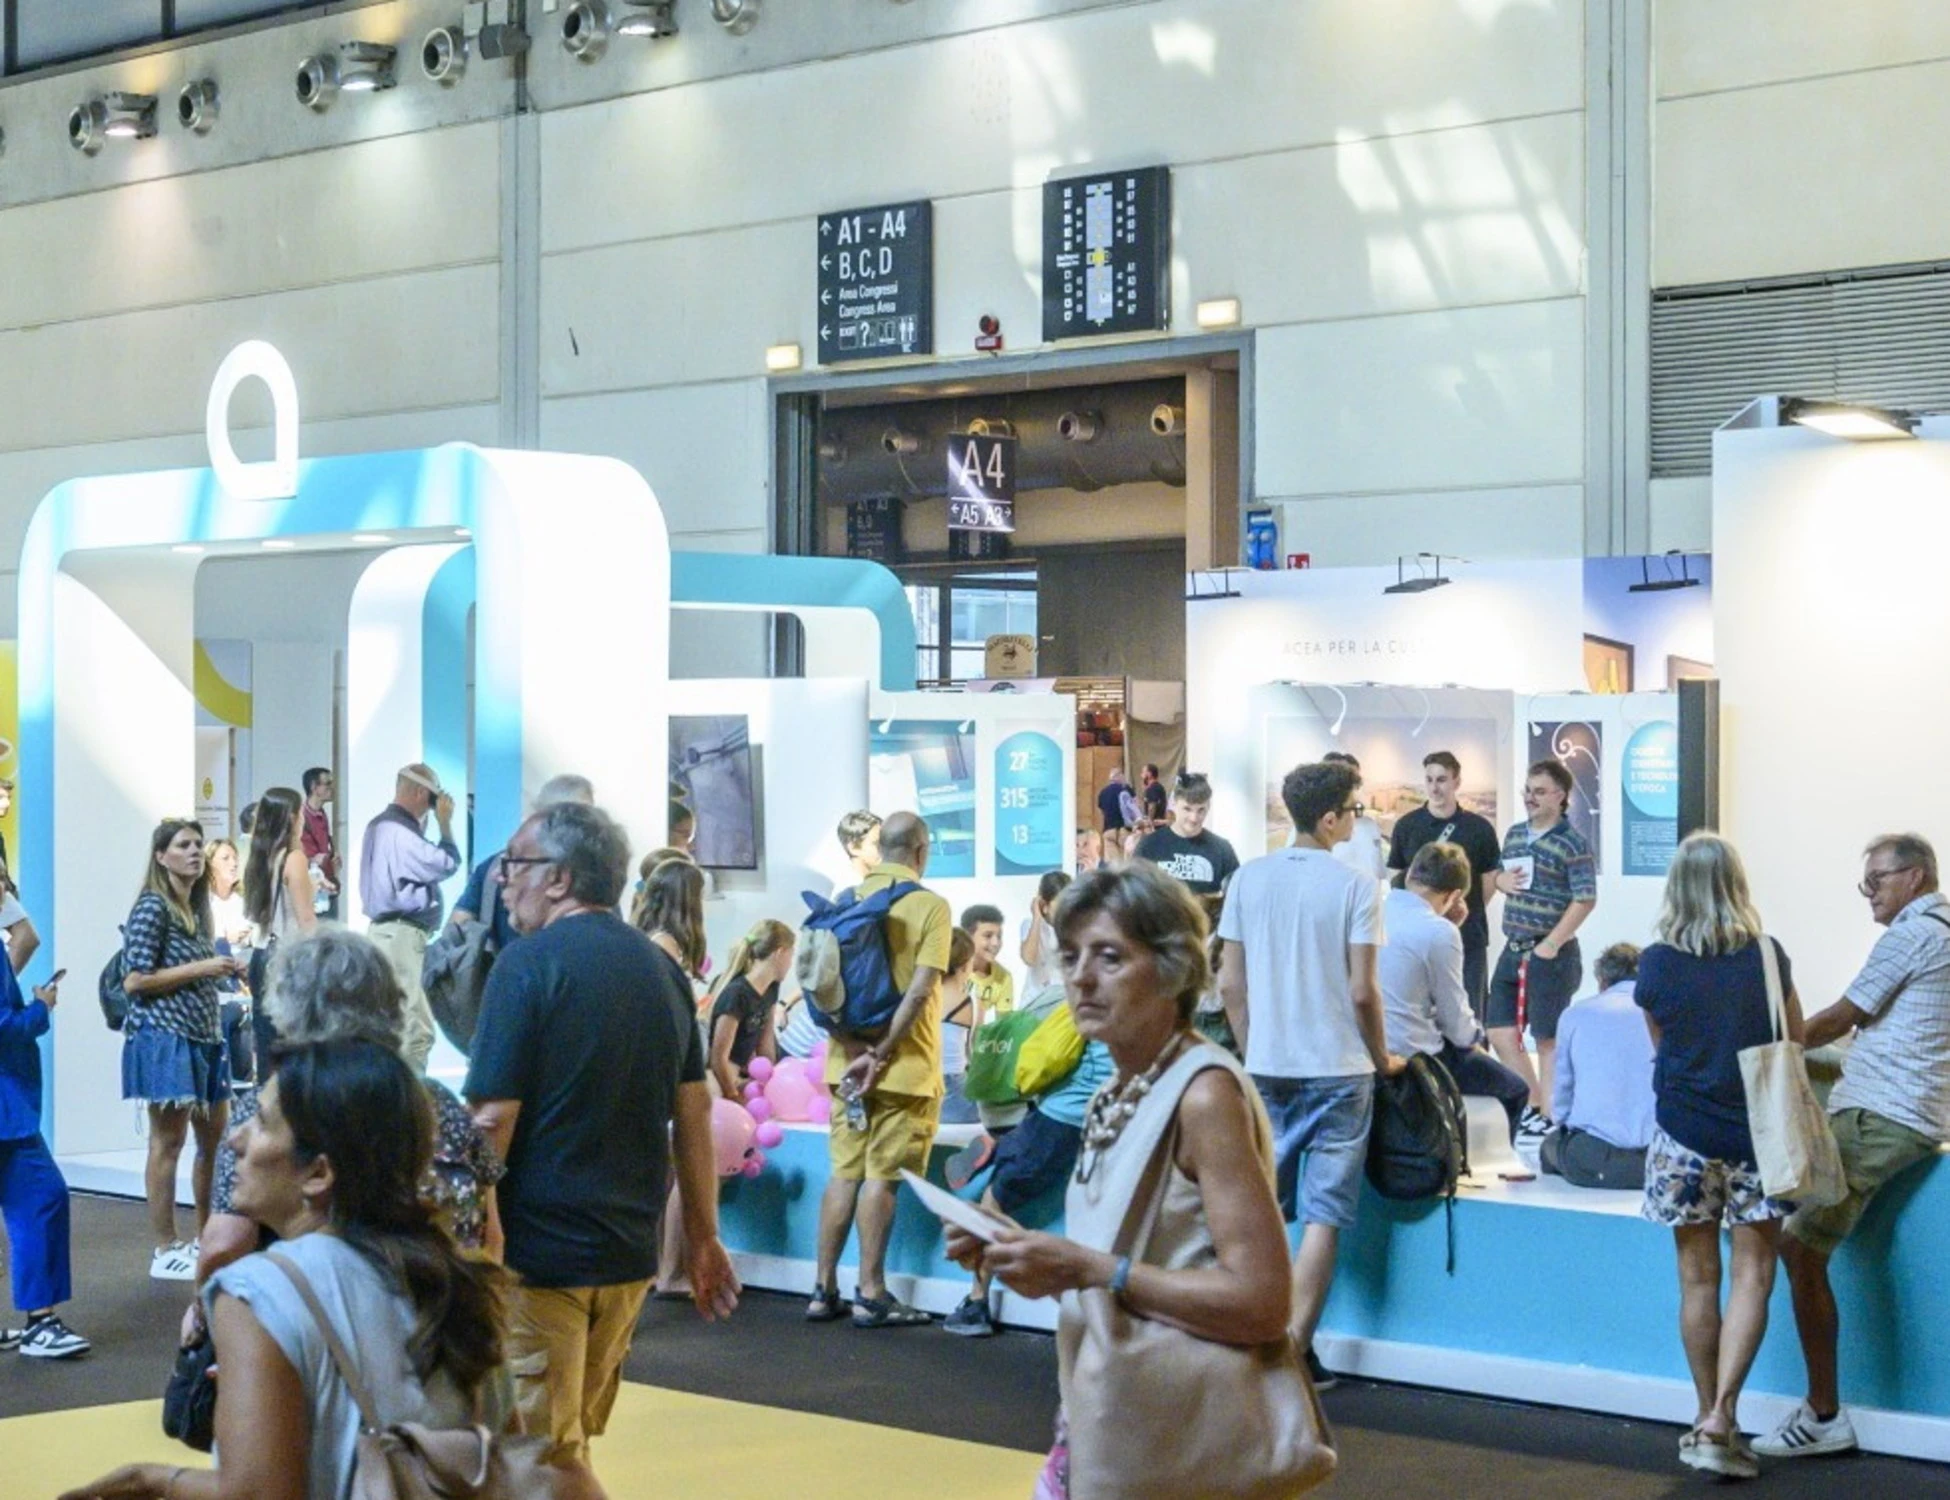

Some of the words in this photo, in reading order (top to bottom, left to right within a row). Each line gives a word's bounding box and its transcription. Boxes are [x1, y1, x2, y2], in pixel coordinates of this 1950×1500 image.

[837, 216, 860, 246] A1
[881, 209, 906, 240] A4
[959, 440, 1005, 488] A4
[961, 503, 979, 525] A5
[985, 505, 1003, 526] A3
[1328, 640, 1357, 654] PER
[1363, 640, 1381, 654] LA
[1009, 751, 1029, 771] 27
[1000, 787, 1029, 808] 315
[1012, 824, 1028, 844] 13
